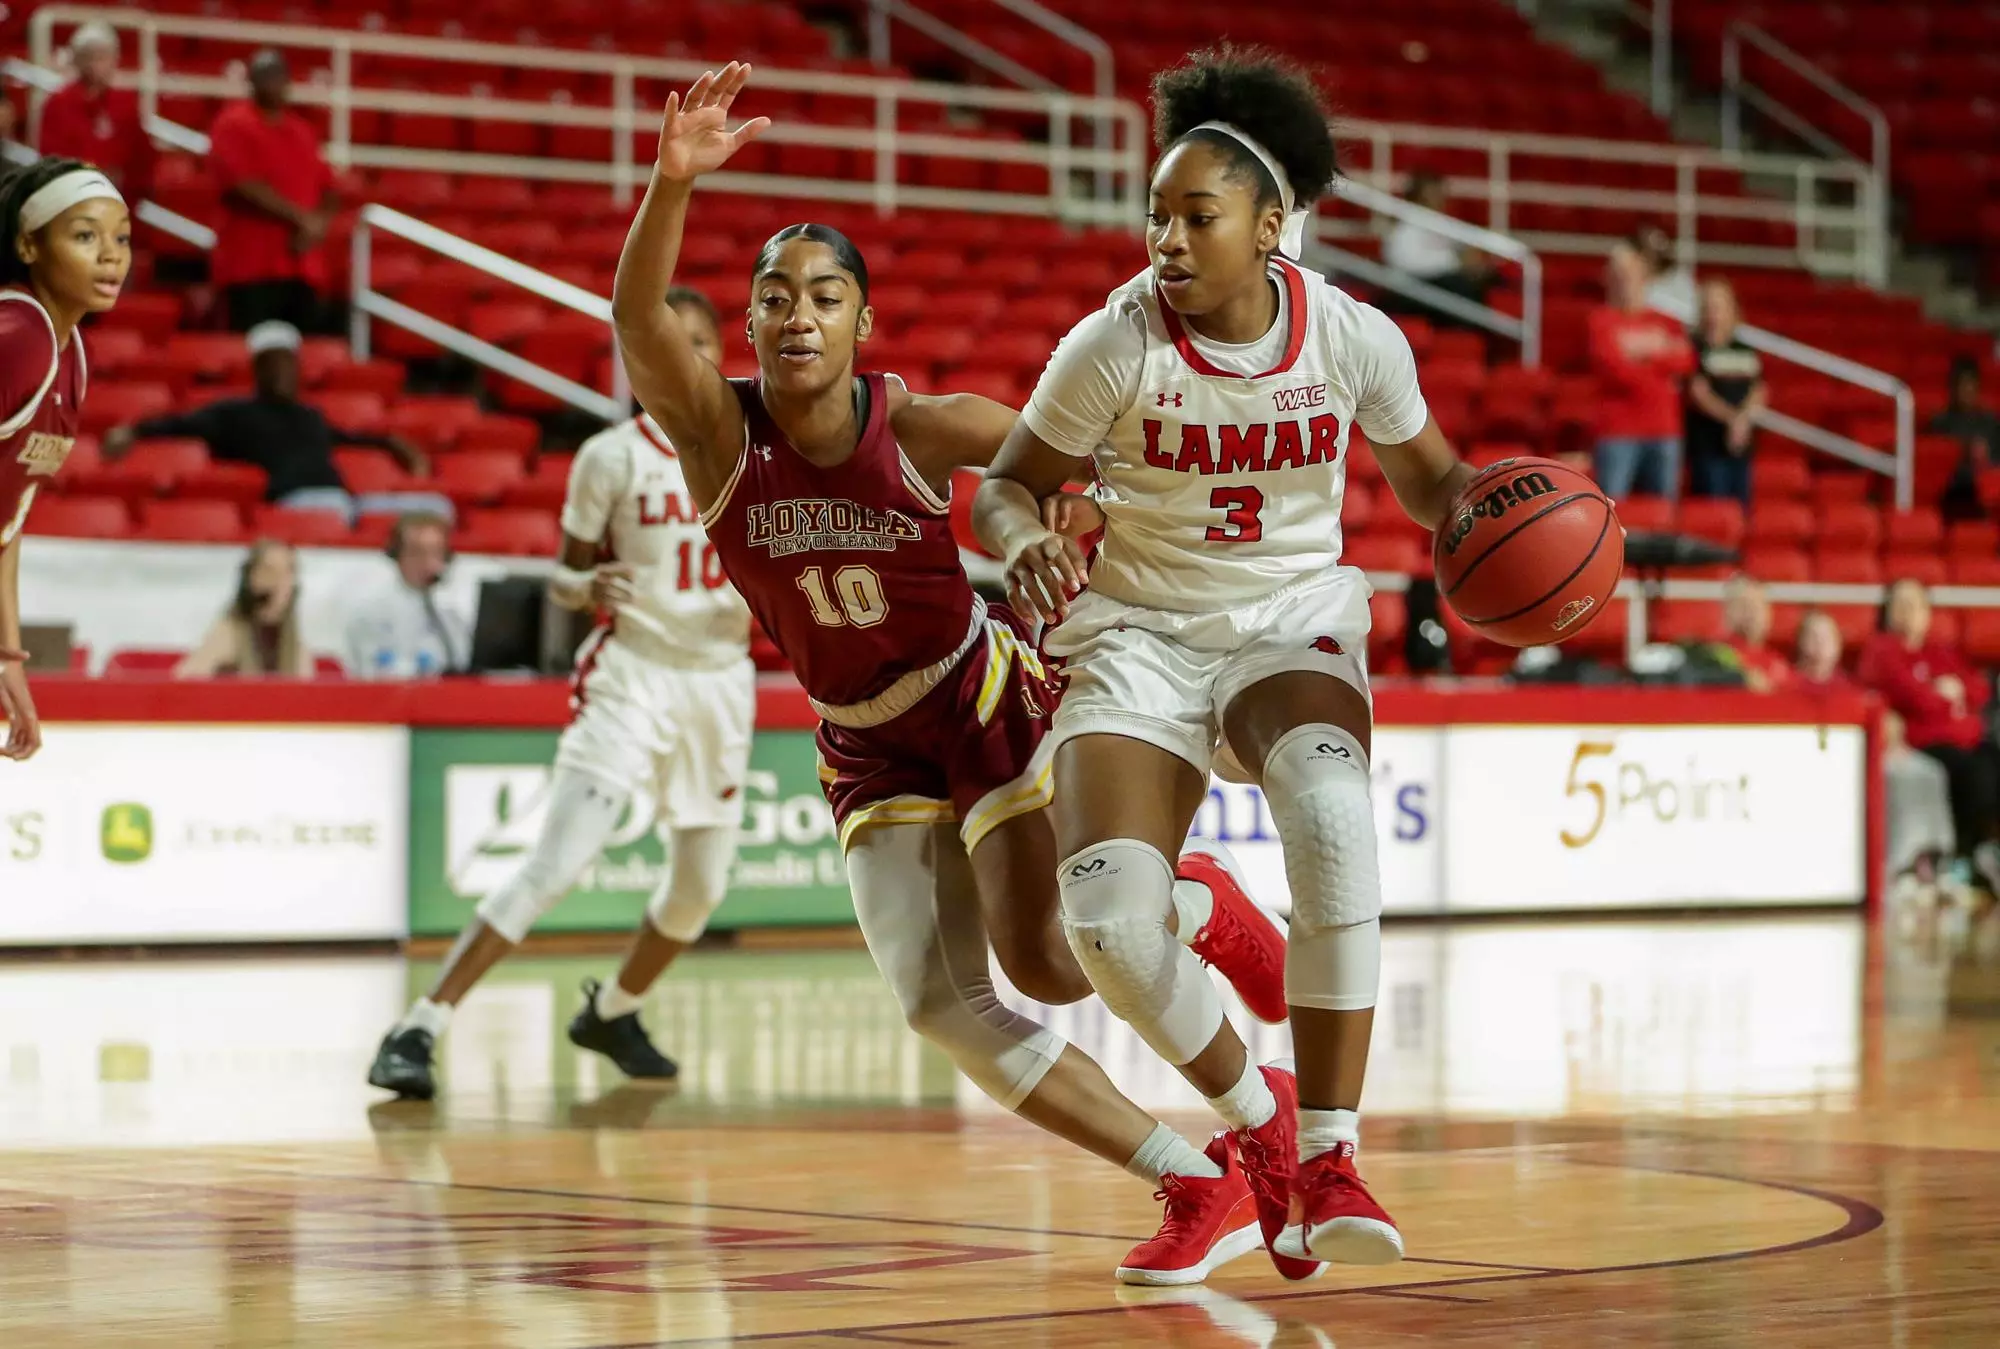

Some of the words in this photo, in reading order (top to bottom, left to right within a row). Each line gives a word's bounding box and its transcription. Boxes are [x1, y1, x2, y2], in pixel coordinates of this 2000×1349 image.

[1272, 383, 1327, 412] WAC
[1142, 412, 1340, 476] LAMAR
[747, 498, 922, 547] LOYOLA
[1204, 485, 1264, 543] 3
[769, 538, 809, 558] NEW
[810, 533, 897, 553] ORLEANS
[794, 564, 890, 629] 10
